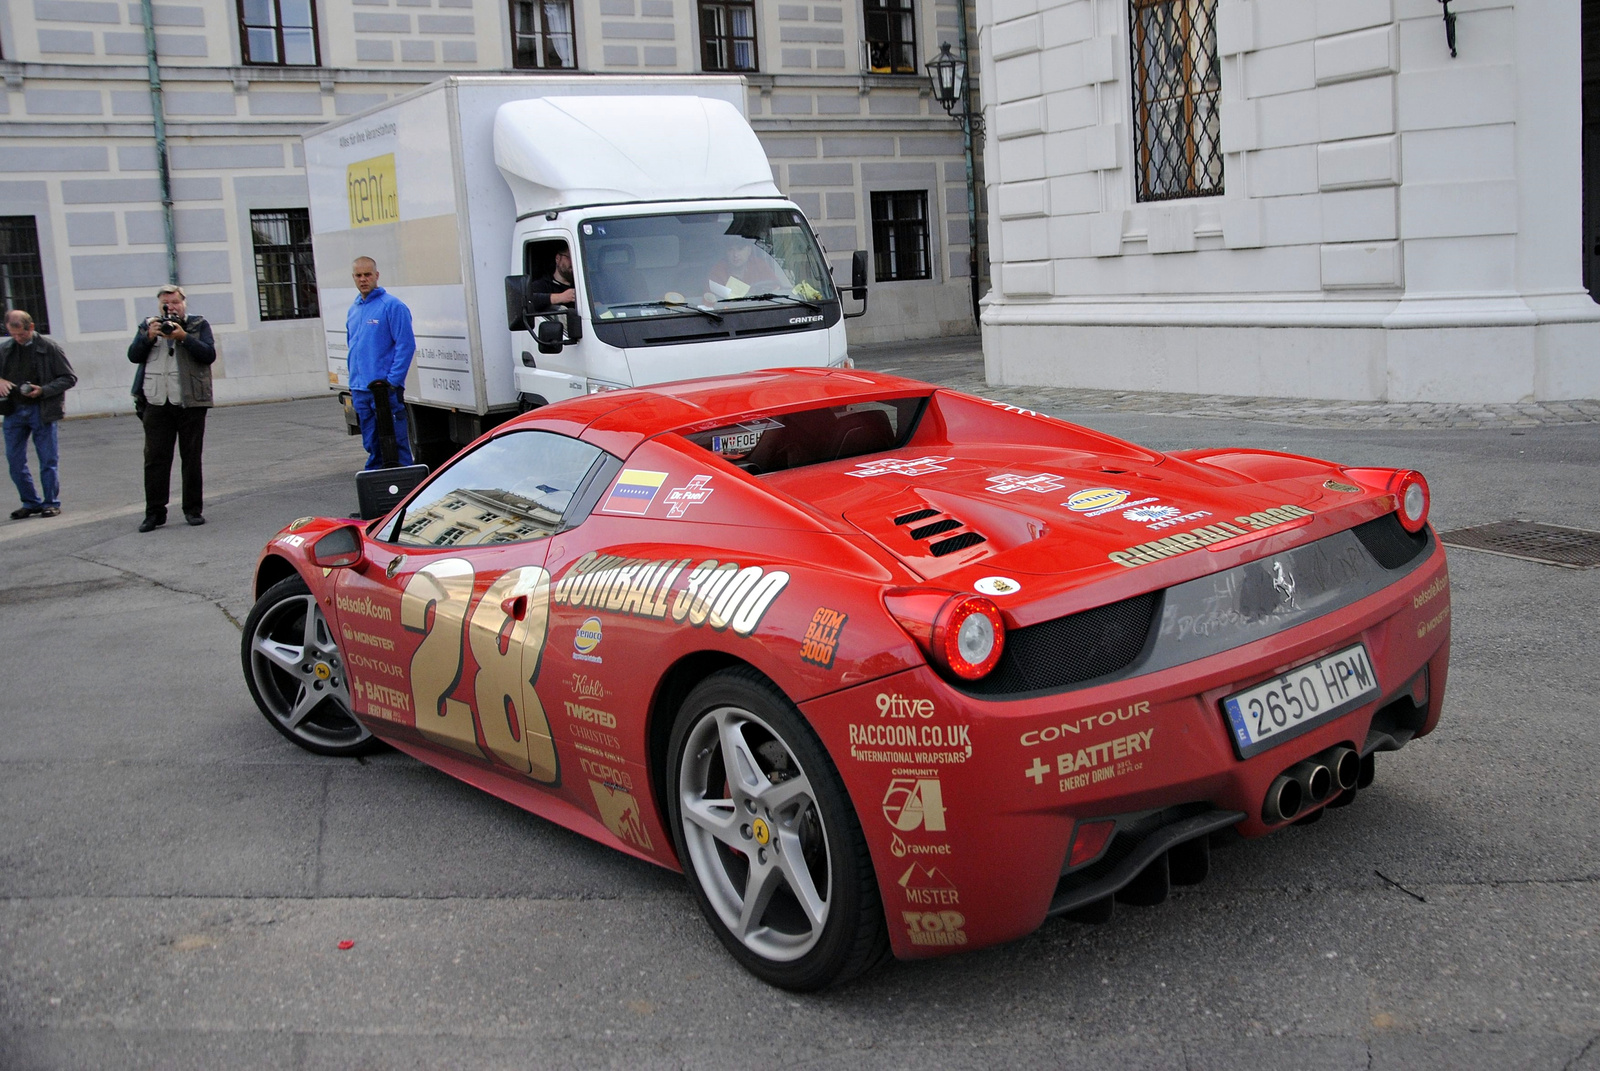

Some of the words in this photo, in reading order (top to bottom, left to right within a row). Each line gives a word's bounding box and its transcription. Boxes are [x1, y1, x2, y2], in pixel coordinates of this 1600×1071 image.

[789, 314, 824, 324] CANTER
[721, 437, 729, 450] W
[670, 492, 682, 500] Dr.
[682, 491, 705, 500] Fuel
[1108, 521, 1250, 568] GUMBALL
[1234, 504, 1315, 530] 3000
[554, 550, 693, 620] GUMBALL
[672, 559, 790, 637] 3000
[812, 606, 848, 628] GUM
[354, 630, 394, 651] MONSTER
[804, 622, 838, 646] BALL
[800, 638, 834, 666] 3000
[348, 653, 404, 678] CONTOUR
[400, 557, 561, 788] 28
[365, 681, 410, 711] BATTERY
[572, 673, 604, 698] Kiehl's
[1248, 676, 1320, 737] 2650
[1320, 653, 1371, 704] HPM
[564, 701, 616, 728] TWISTED
[876, 693, 935, 718] 9five
[849, 724, 971, 746] RACCOON.CO.UK
[1020, 700, 1150, 746] CONTOUR
[1238, 728, 1247, 740] E
[569, 723, 620, 749] CHRISTIE'S
[1057, 728, 1154, 775] BATTERY
[892, 768, 939, 776] COMMUNITY
[1059, 773, 1090, 792] ENERGY
[1092, 765, 1115, 783] DRINK
[908, 843, 951, 855] rawnet
[906, 889, 959, 904] MISTER
[902, 910, 965, 932] TOP
